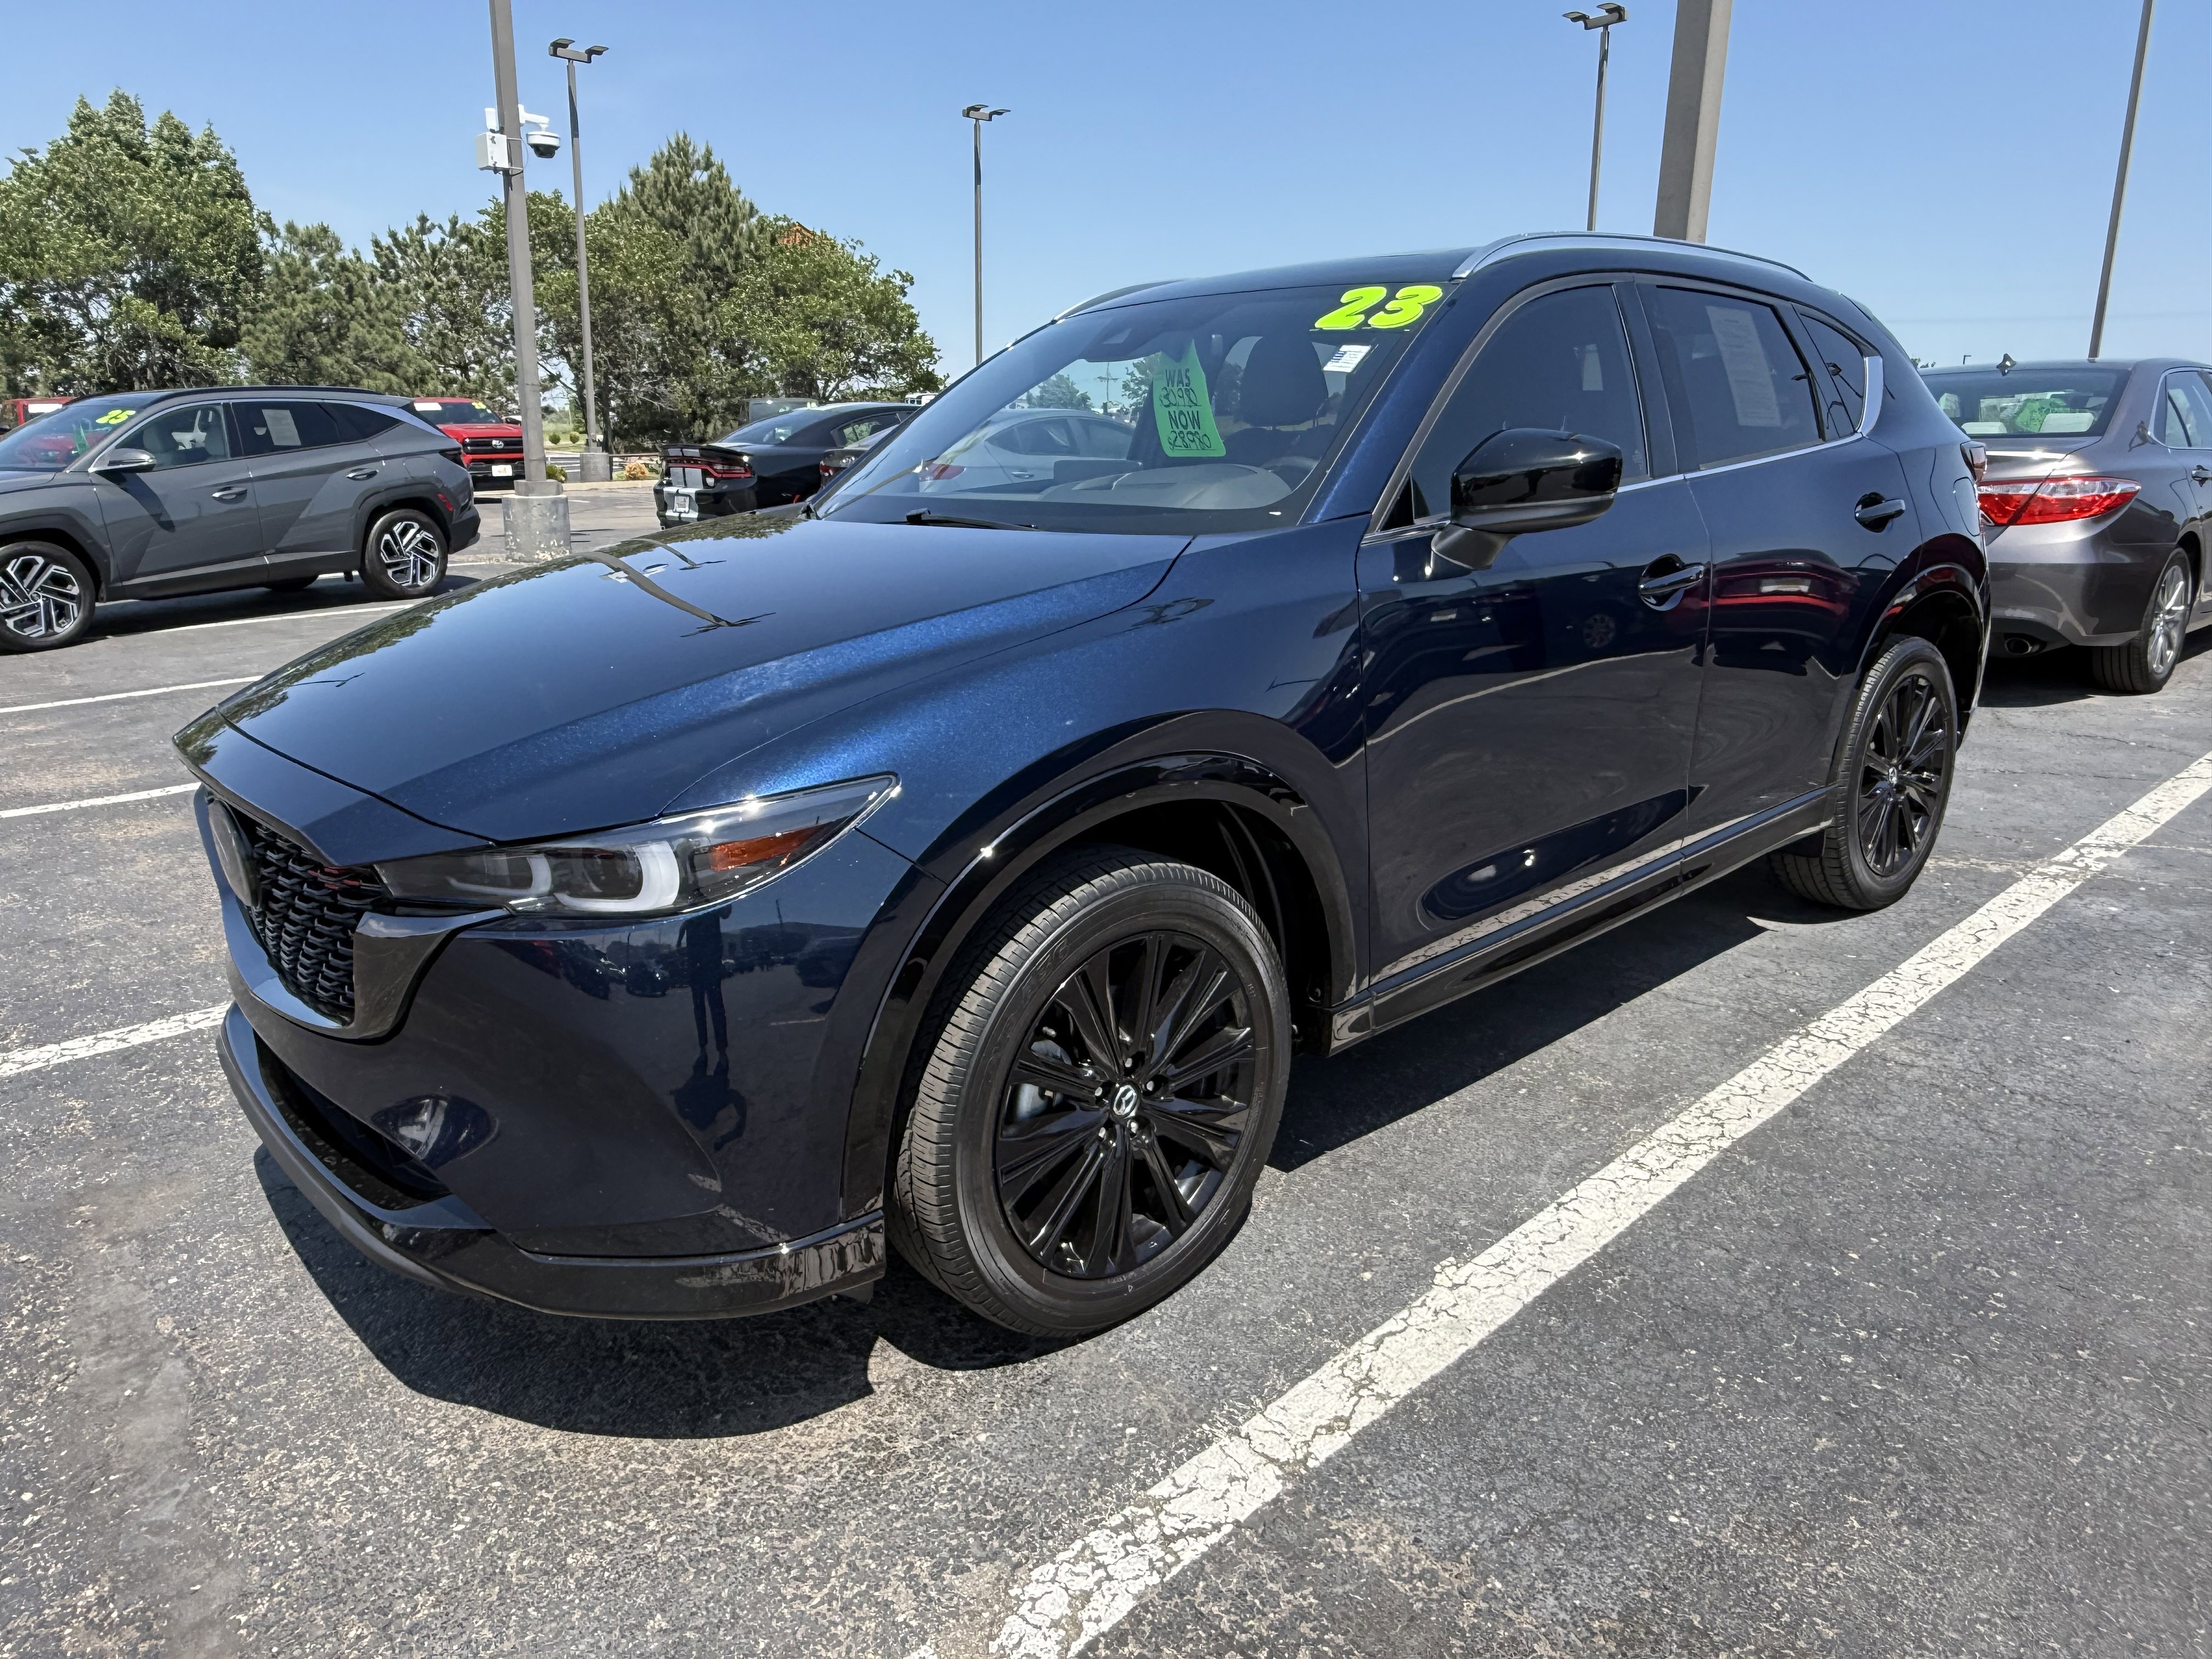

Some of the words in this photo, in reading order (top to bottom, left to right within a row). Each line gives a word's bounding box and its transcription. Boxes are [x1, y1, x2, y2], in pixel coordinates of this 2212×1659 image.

[1314, 285, 1443, 329] 23
[1165, 368, 1191, 387] WAS
[95, 409, 136, 425] 25
[1167, 410, 1201, 430] NOW
